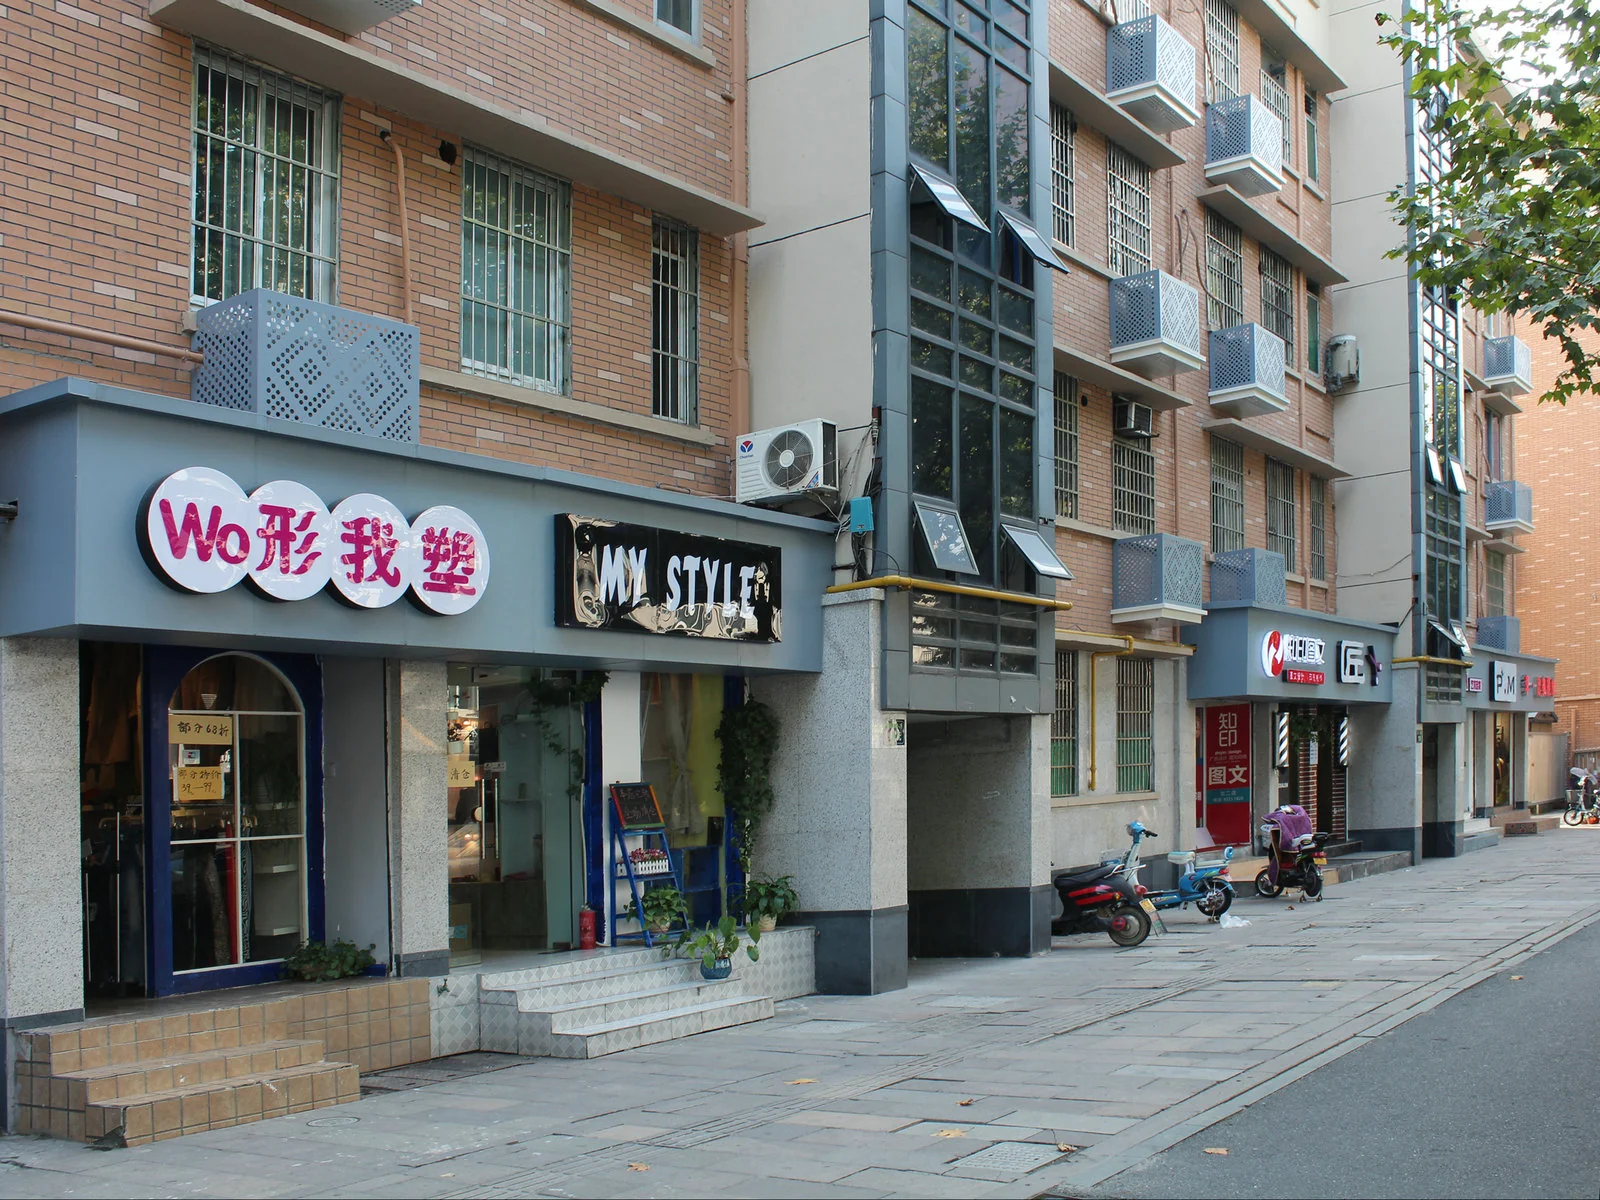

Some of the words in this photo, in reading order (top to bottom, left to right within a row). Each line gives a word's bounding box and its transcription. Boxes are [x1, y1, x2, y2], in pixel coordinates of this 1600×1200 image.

[600, 543, 648, 608] MY
[665, 554, 756, 620] STYLE
[1208, 765, 1248, 785] 图文
